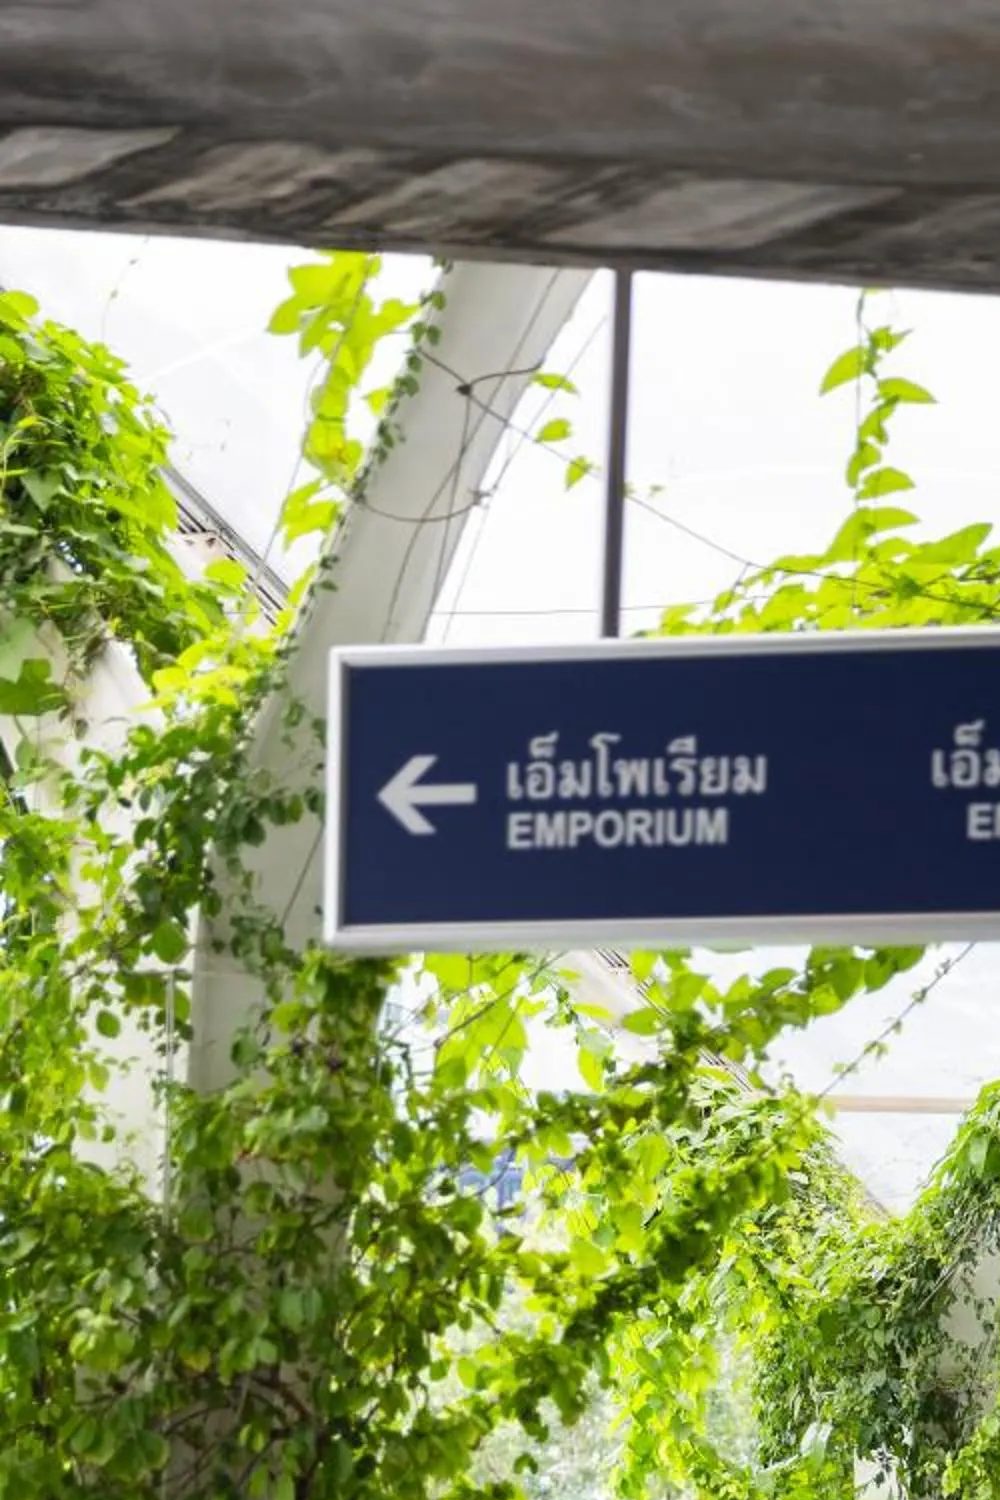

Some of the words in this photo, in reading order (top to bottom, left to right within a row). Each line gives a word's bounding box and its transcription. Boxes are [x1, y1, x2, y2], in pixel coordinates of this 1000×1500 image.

[507, 731, 767, 800] เอ็มโพเรียม
[507, 808, 728, 849] EMPORIUM
